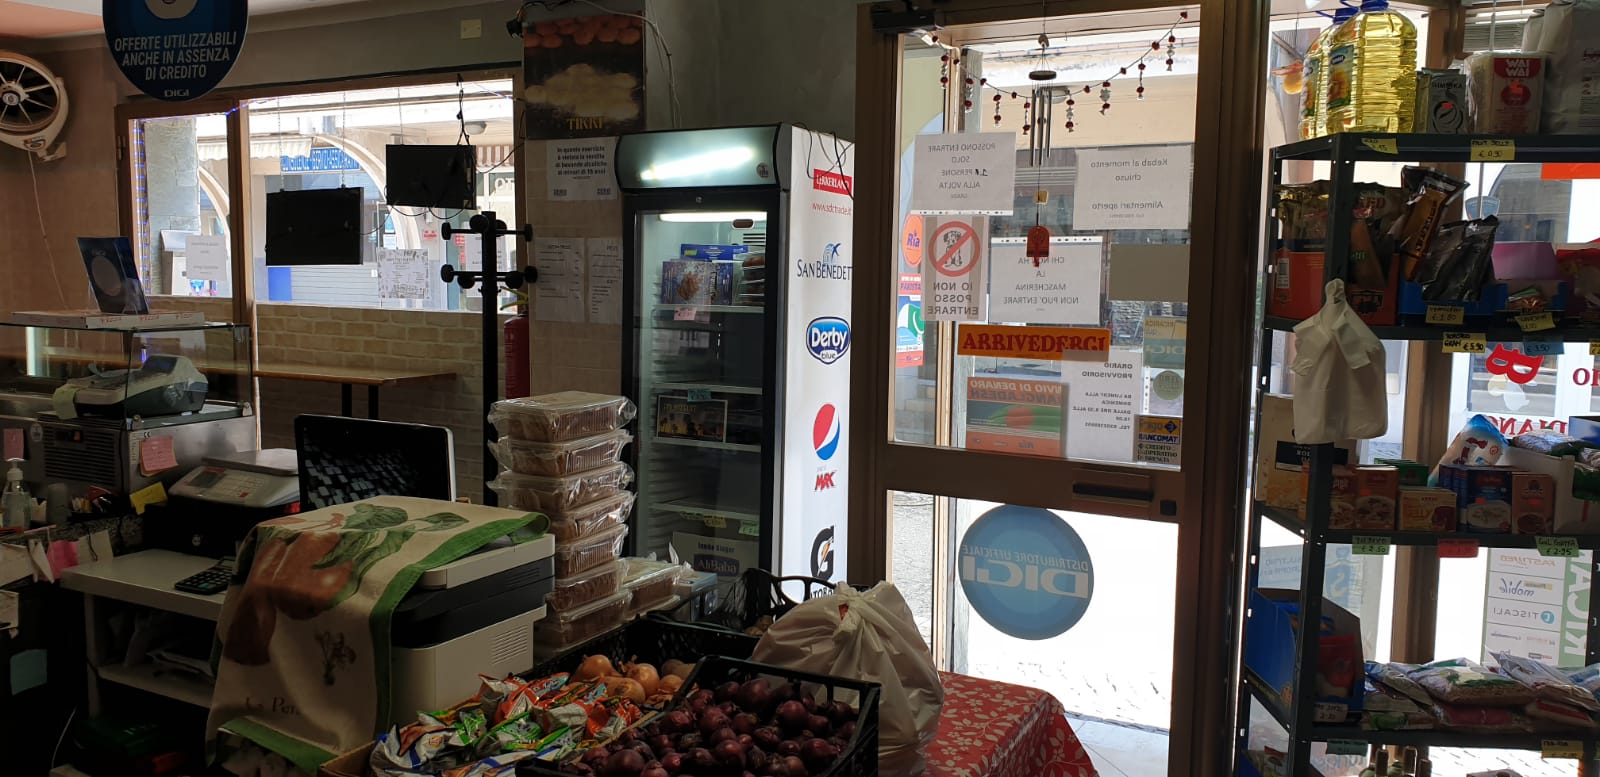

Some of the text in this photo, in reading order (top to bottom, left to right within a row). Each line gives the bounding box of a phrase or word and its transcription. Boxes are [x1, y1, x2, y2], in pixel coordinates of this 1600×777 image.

[114, 31, 237, 52] OFFERTE UTILIZZABILI
[122, 47, 230, 66] ANCHE IN ASSENZA
[1505, 58, 1530, 68] WAI
[145, 64, 207, 80] DI CREDITO
[1505, 67, 1530, 77] WAI
[164, 89, 190, 97] DIGI
[906, 232, 920, 248] Ria
[796, 259, 815, 278] SAN
[811, 326, 848, 350] Derby
[820, 349, 836, 359] blue
